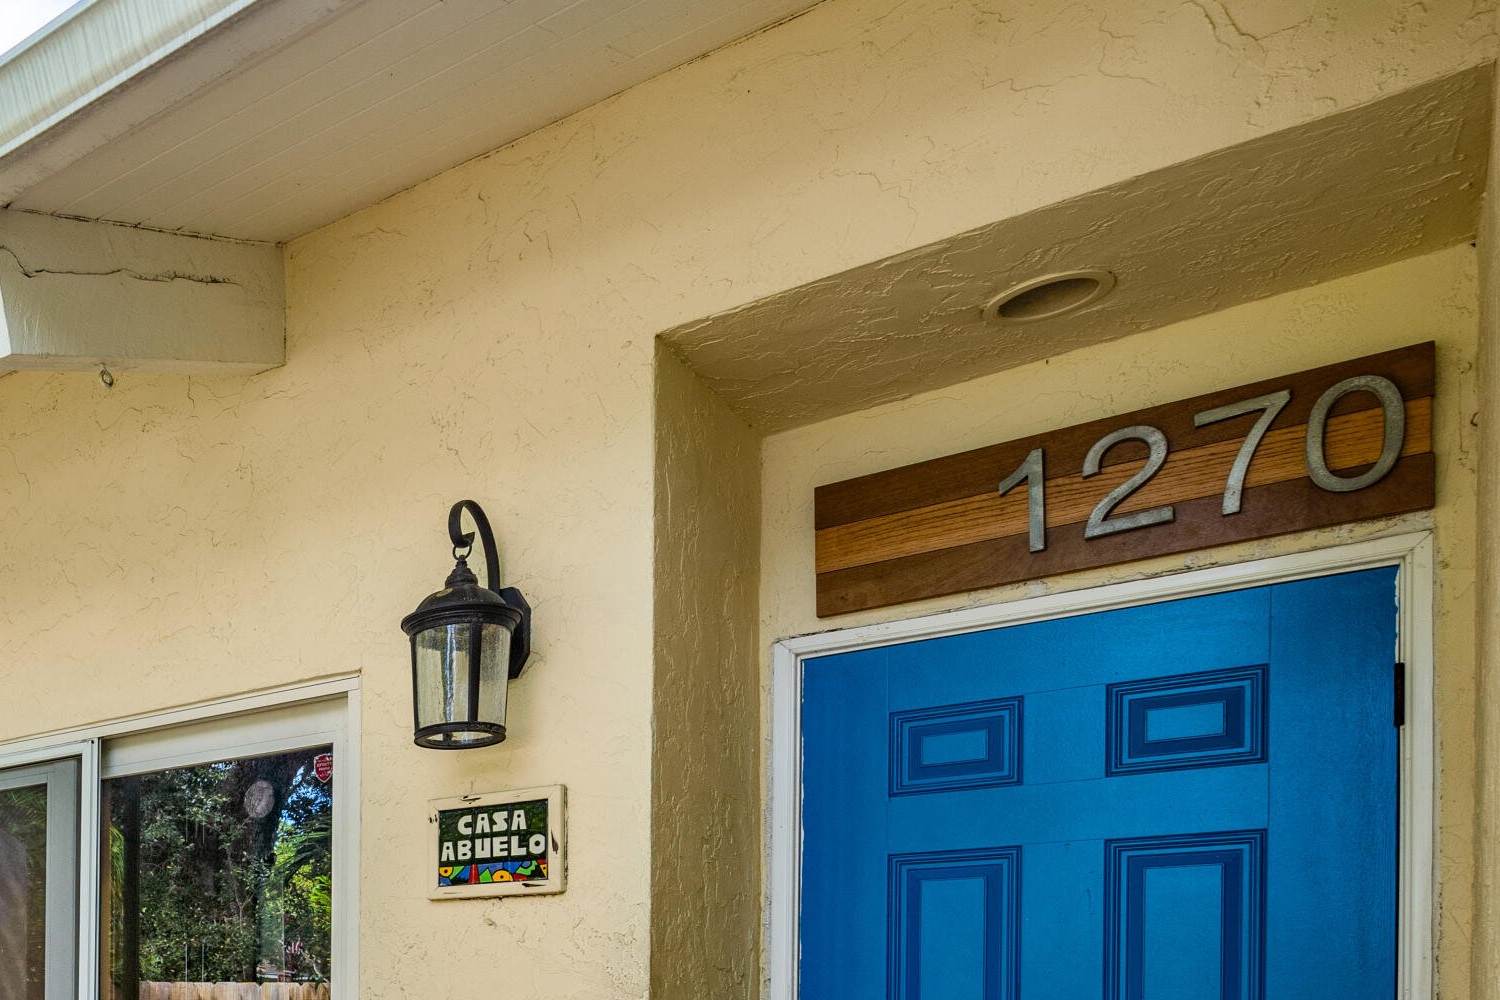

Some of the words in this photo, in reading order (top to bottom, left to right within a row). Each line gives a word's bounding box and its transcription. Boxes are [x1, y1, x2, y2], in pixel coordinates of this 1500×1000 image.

[999, 374, 1406, 552] 1270
[457, 809, 527, 836] CASA
[440, 833, 546, 862] ABUELO
